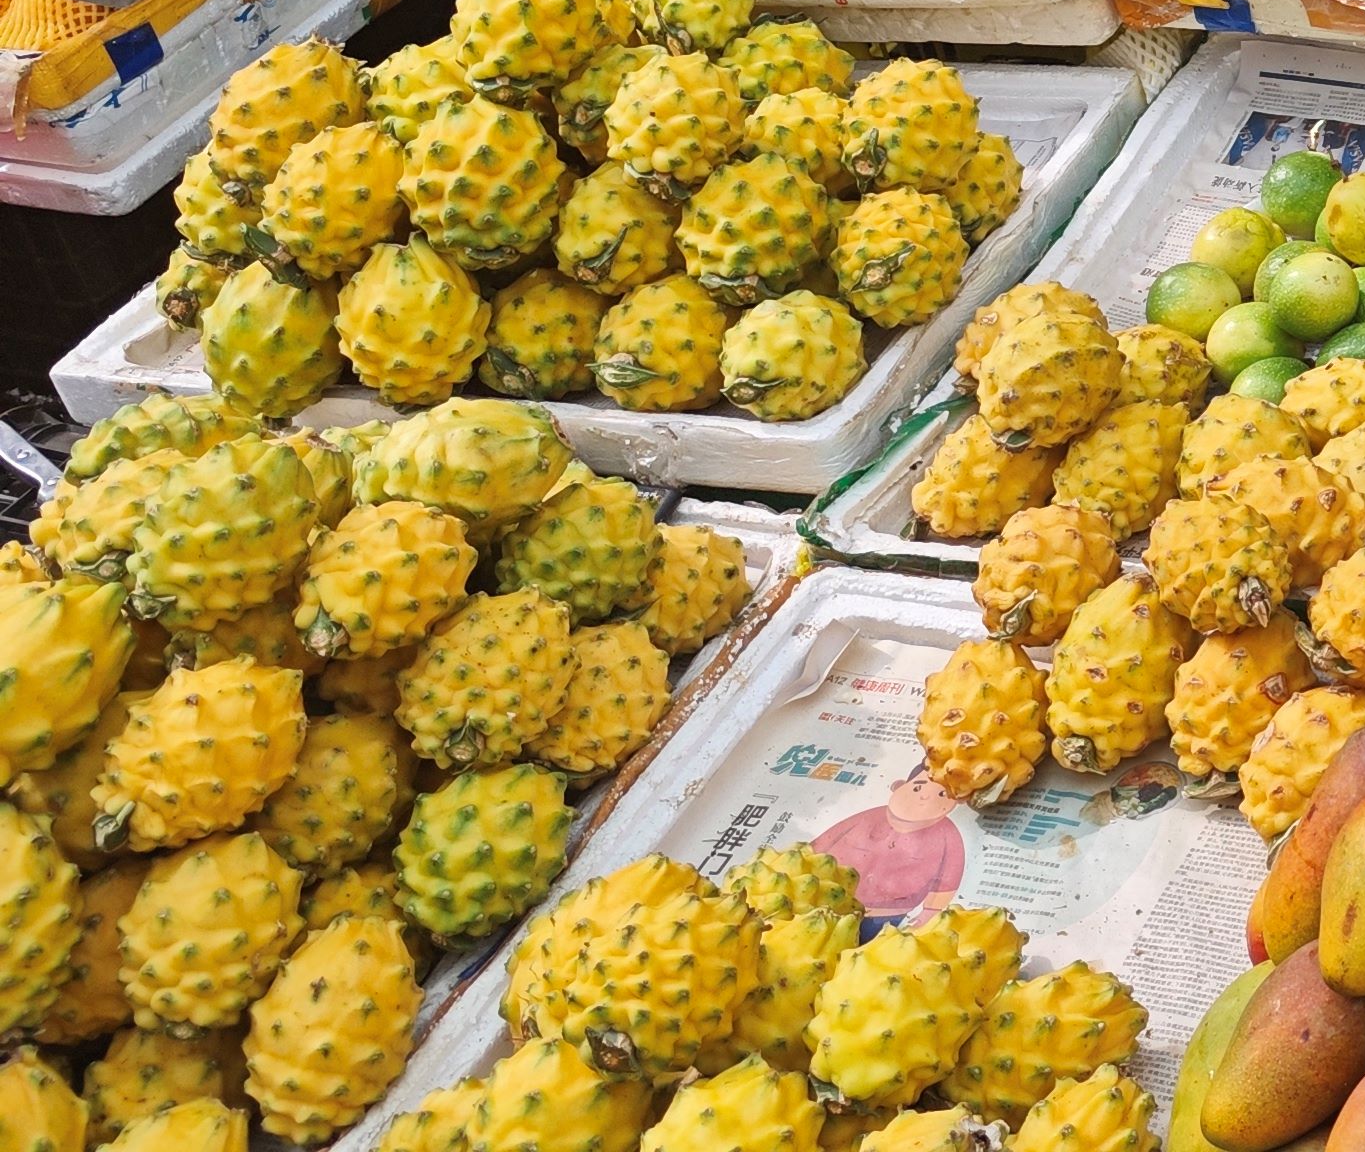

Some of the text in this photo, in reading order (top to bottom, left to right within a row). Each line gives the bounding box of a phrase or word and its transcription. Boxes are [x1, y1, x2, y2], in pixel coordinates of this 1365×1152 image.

[1211, 176, 1262, 194] 入新动能
[826, 674, 848, 687] A12
[851, 677, 906, 696] 健康周刊
